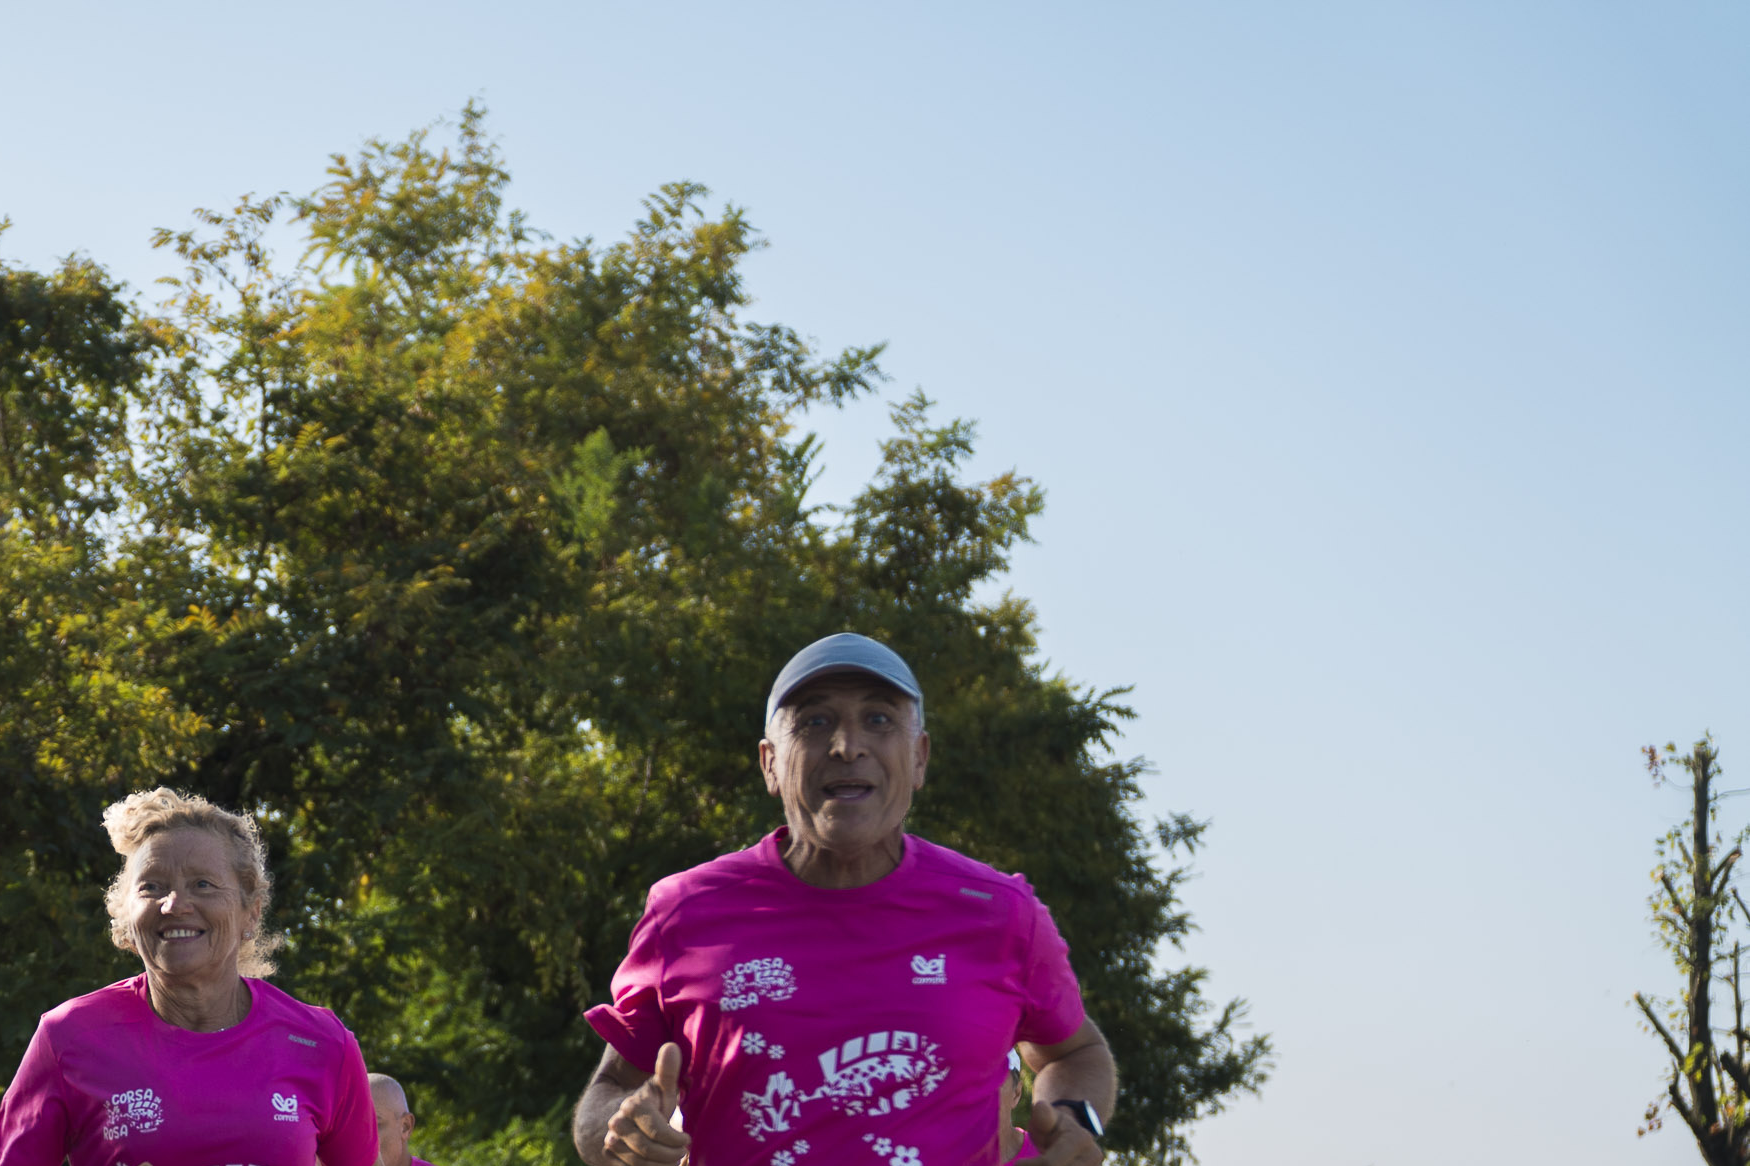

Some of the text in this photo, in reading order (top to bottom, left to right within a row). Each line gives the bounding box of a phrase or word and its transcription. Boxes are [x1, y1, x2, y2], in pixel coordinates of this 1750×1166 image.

[734, 957, 784, 975] CORSA
[720, 992, 759, 1012] ROSA
[111, 1088, 153, 1106] CORSA
[103, 1125, 128, 1140] ROSA
